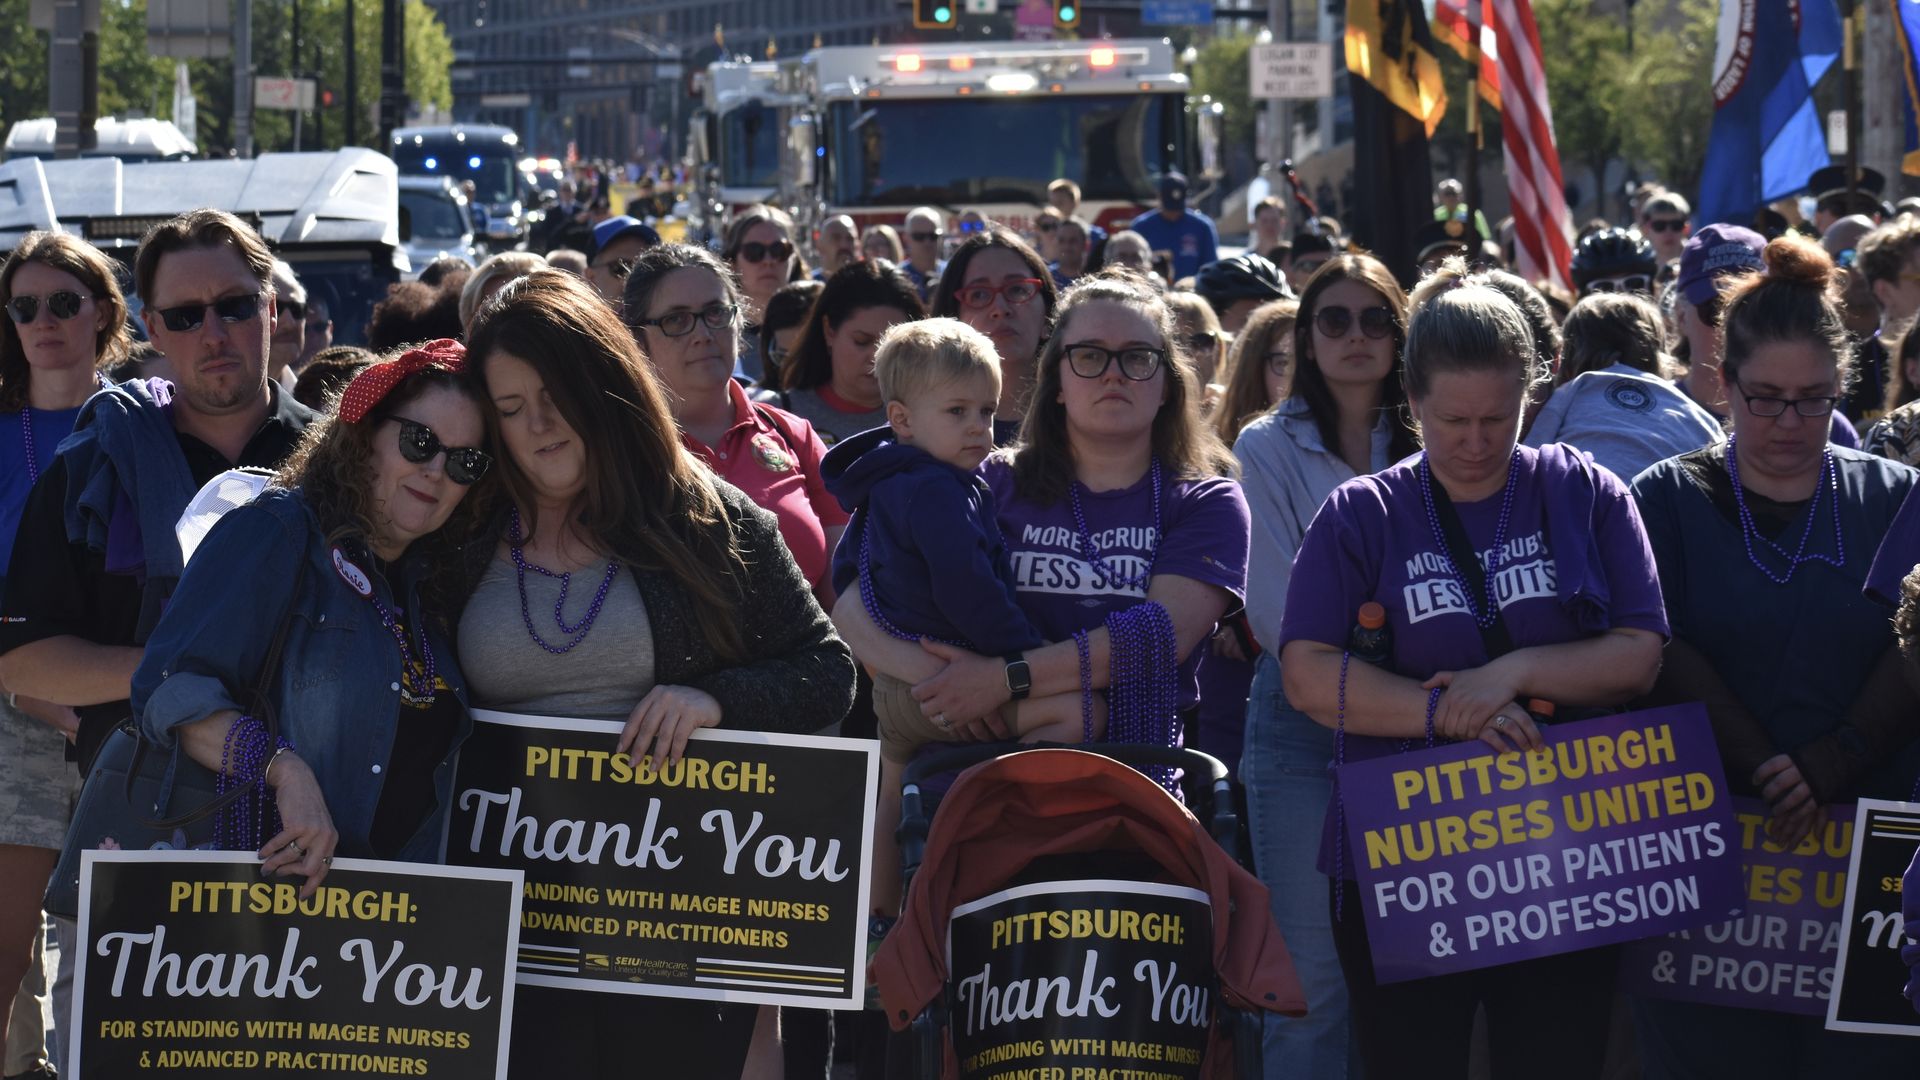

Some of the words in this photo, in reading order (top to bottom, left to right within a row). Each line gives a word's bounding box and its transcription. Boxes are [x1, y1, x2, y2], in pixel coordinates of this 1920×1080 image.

[1022, 524, 1081, 553] MORE
[1090, 526, 1156, 553] SCRUB
[336, 556, 364, 591] Rosie
[1013, 555, 1081, 590] LESS
[1091, 558, 1150, 594] SUIT
[1406, 551, 1453, 580] MOR
[1410, 582, 1466, 617] LES
[1496, 564, 1557, 603] UITS
[526, 746, 776, 795] PITTSBURGH:
[1392, 724, 1677, 810] PITTSBURGH
[459, 787, 683, 870] Thank
[701, 810, 849, 882] You
[1365, 800, 1554, 869] NURSES
[1562, 772, 1716, 832] UNITED
[1375, 872, 1457, 917] FOR
[1467, 855, 1554, 899] OUR
[1562, 821, 1726, 884] PATIENTS
[170, 879, 418, 924] PITTSBURGH:
[524, 882, 600, 905] ANDING
[606, 888, 664, 910] WITH
[671, 893, 741, 916] MAGEE
[747, 898, 830, 922] NURSES
[1429, 922, 1457, 958] &
[1465, 875, 1700, 951] PROFESSION
[626, 919, 790, 949] PRACTITIONERS
[992, 908, 1185, 950] PITTSBURGH:
[97, 924, 323, 1000] Thank
[340, 938, 492, 1011] You
[1652, 950, 1677, 984] &
[1688, 952, 1836, 1001] PROFES
[959, 949, 1121, 1036] Thank
[1134, 959, 1209, 1028] You
[101, 1018, 137, 1040] FOR
[142, 1019, 240, 1039] STANDING
[246, 1021, 303, 1041] WITH
[309, 1024, 380, 1044] MAGEE
[386, 1027, 472, 1049] NURSES
[979, 1040, 1045, 1068] STANDING
[1050, 1039, 1106, 1056] WITH
[1112, 1040, 1162, 1061] MAGEE
[1165, 1045, 1201, 1065] NURSES
[140, 1049, 152, 1070] &
[157, 1050, 260, 1070] ADVANCED
[265, 1051, 429, 1076] PRACTITIONERS
[988, 1067, 1066, 1080] NCED
[1071, 1067, 1183, 1080] PRACTITIO
